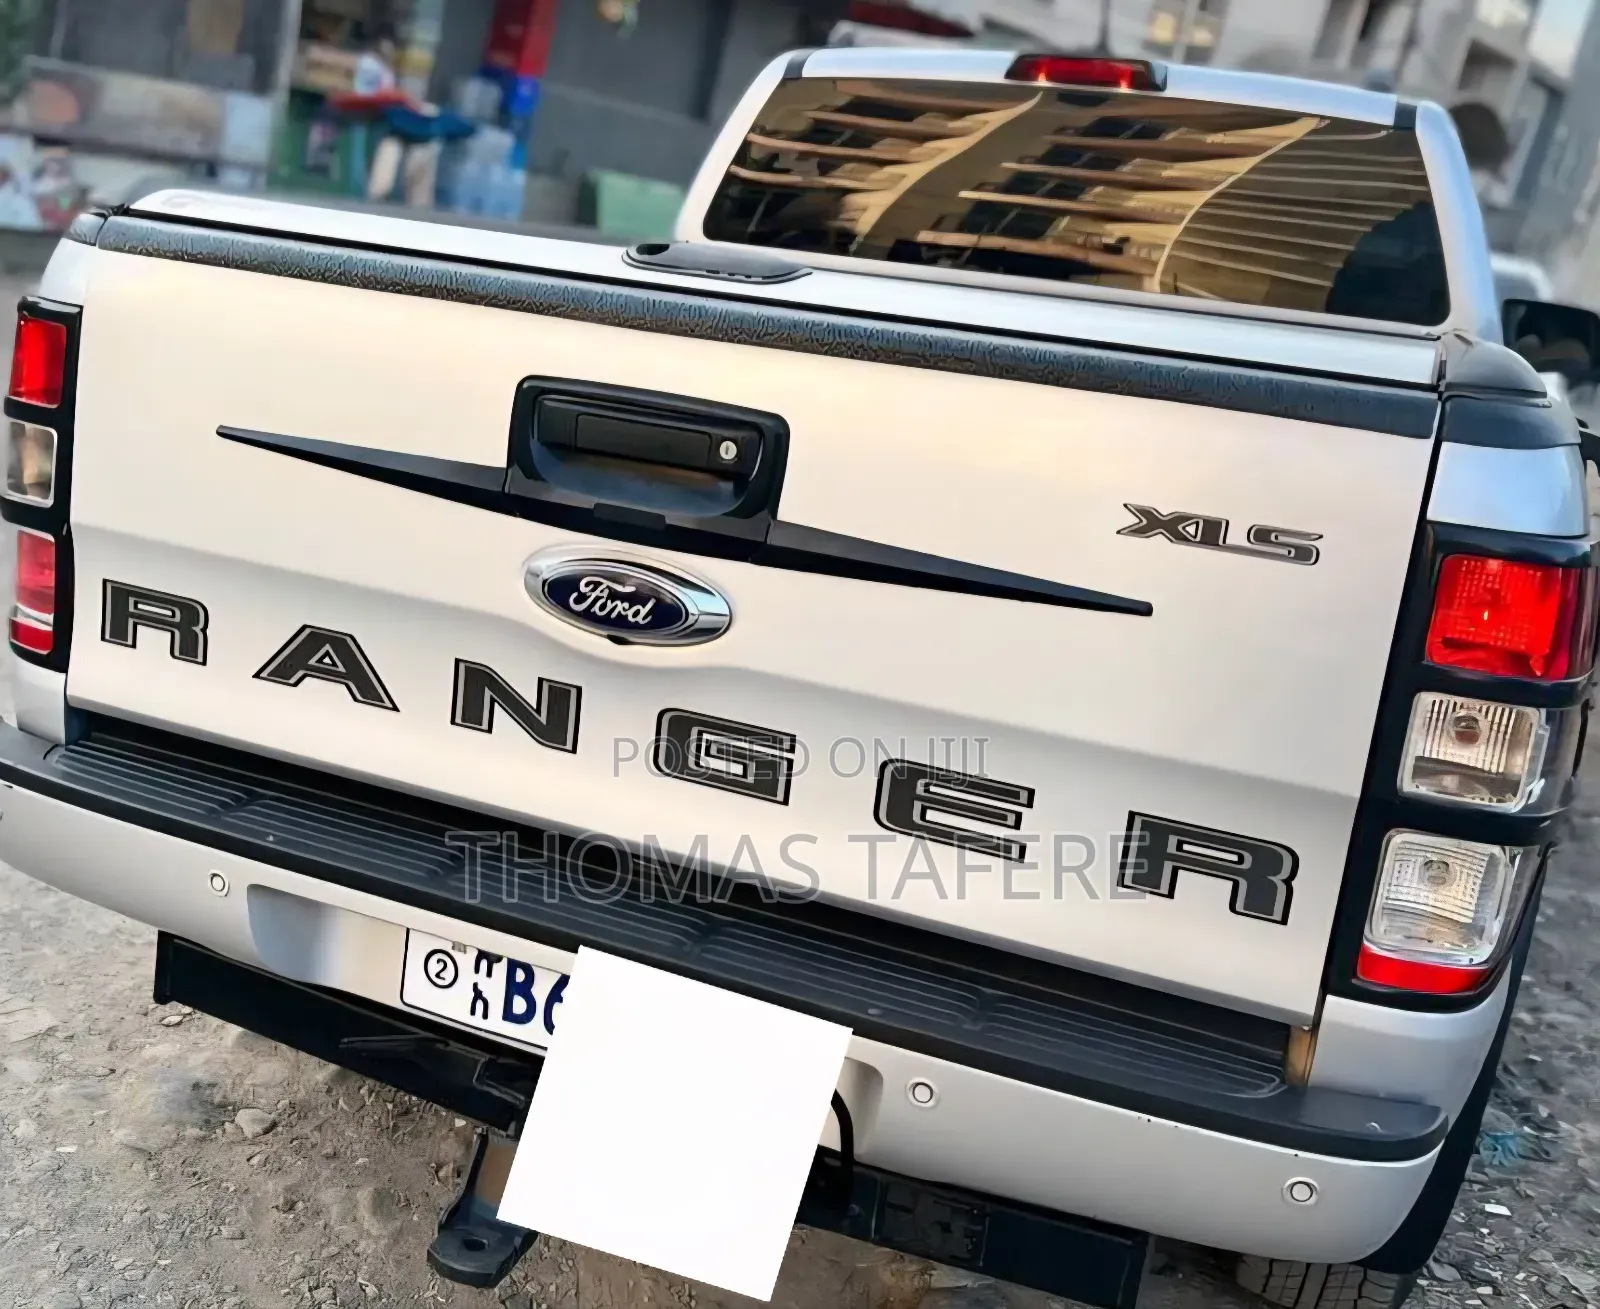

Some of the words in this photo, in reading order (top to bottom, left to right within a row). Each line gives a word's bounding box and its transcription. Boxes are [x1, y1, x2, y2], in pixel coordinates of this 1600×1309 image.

[1116, 503, 1323, 566] XLS
[569, 576, 656, 625] Ford
[100, 578, 1300, 926] RANGER
